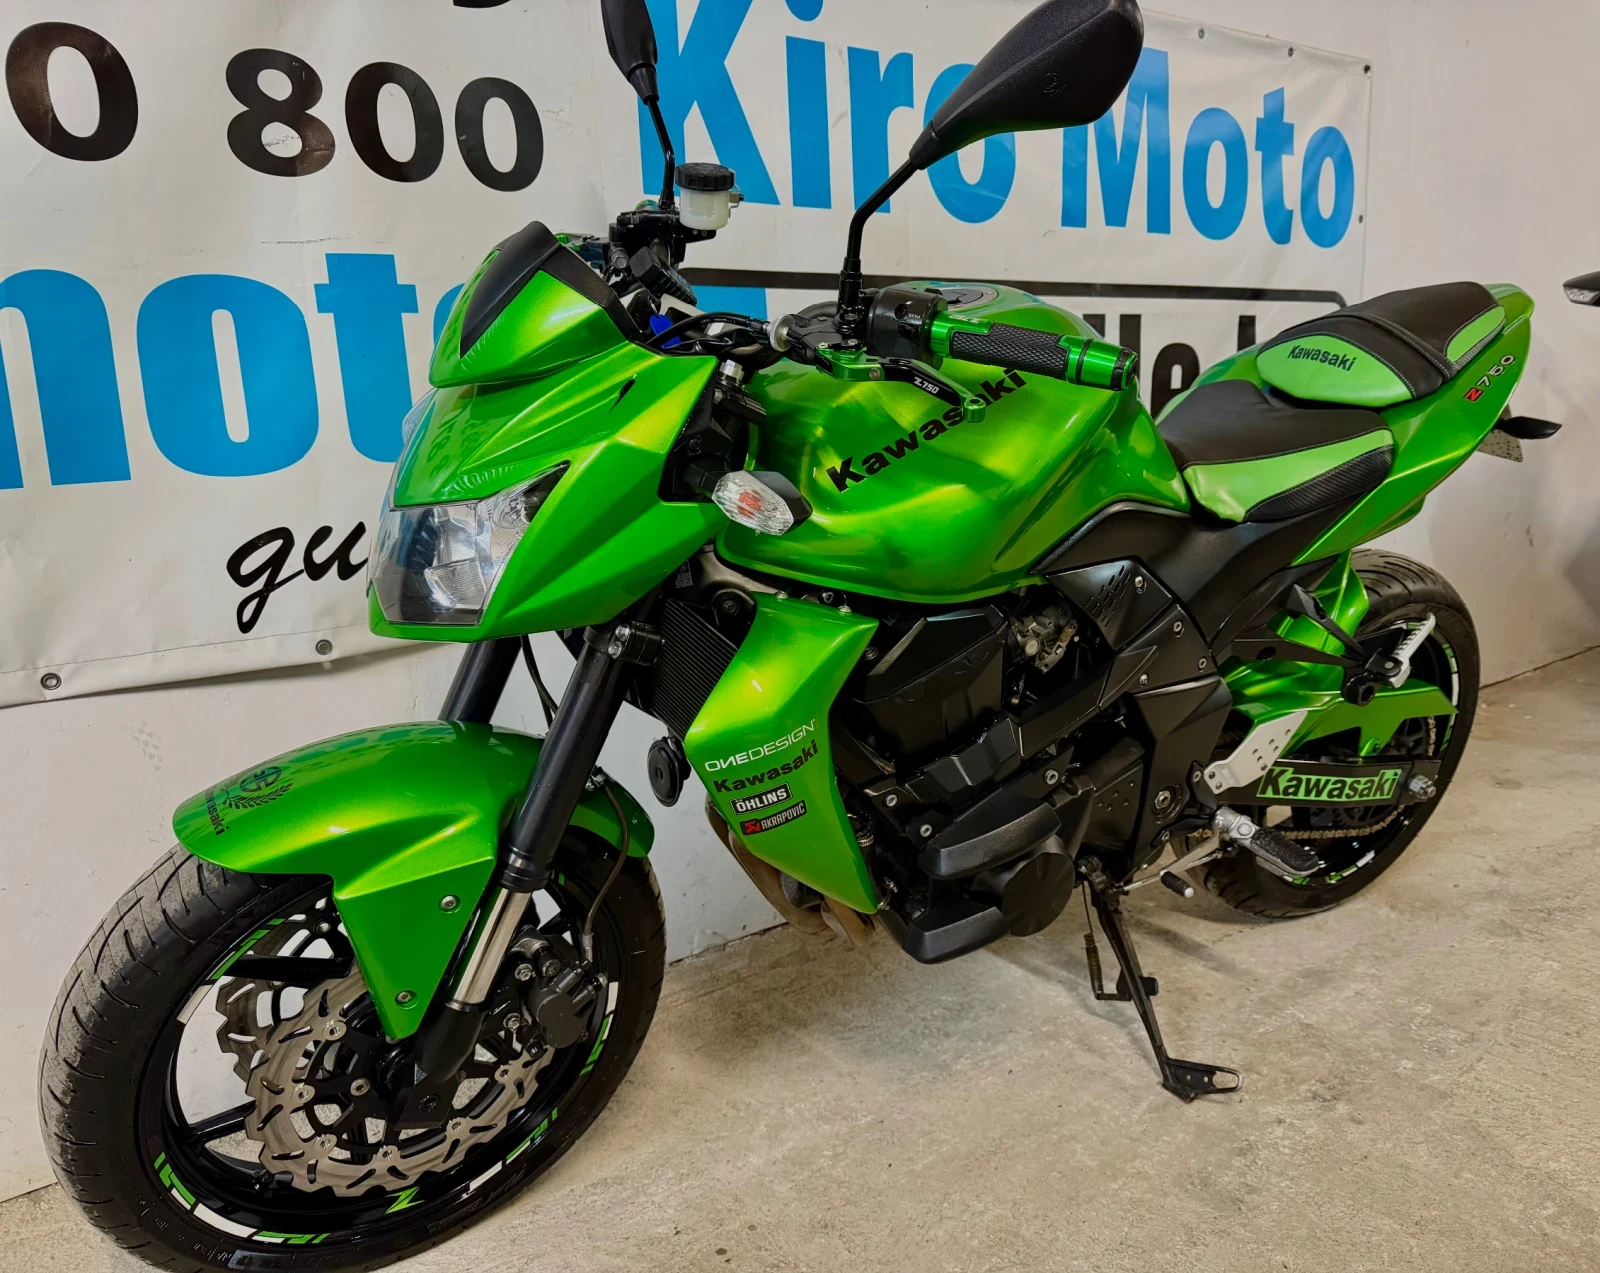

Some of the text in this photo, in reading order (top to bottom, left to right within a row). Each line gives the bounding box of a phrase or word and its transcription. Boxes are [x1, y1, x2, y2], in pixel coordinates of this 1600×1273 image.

[225, 47, 544, 192] 800
[635, 0, 1355, 249] Kiro Moto
[1286, 344, 1356, 372] Kawasaki
[913, 376, 940, 395] Z750
[825, 367, 1028, 494] Kawaski
[704, 719, 816, 772] ONEDESIGN
[713, 739, 819, 793] Kawasaki
[734, 787, 788, 813] ÖHLINS
[1258, 767, 1401, 800] Kawasaki
